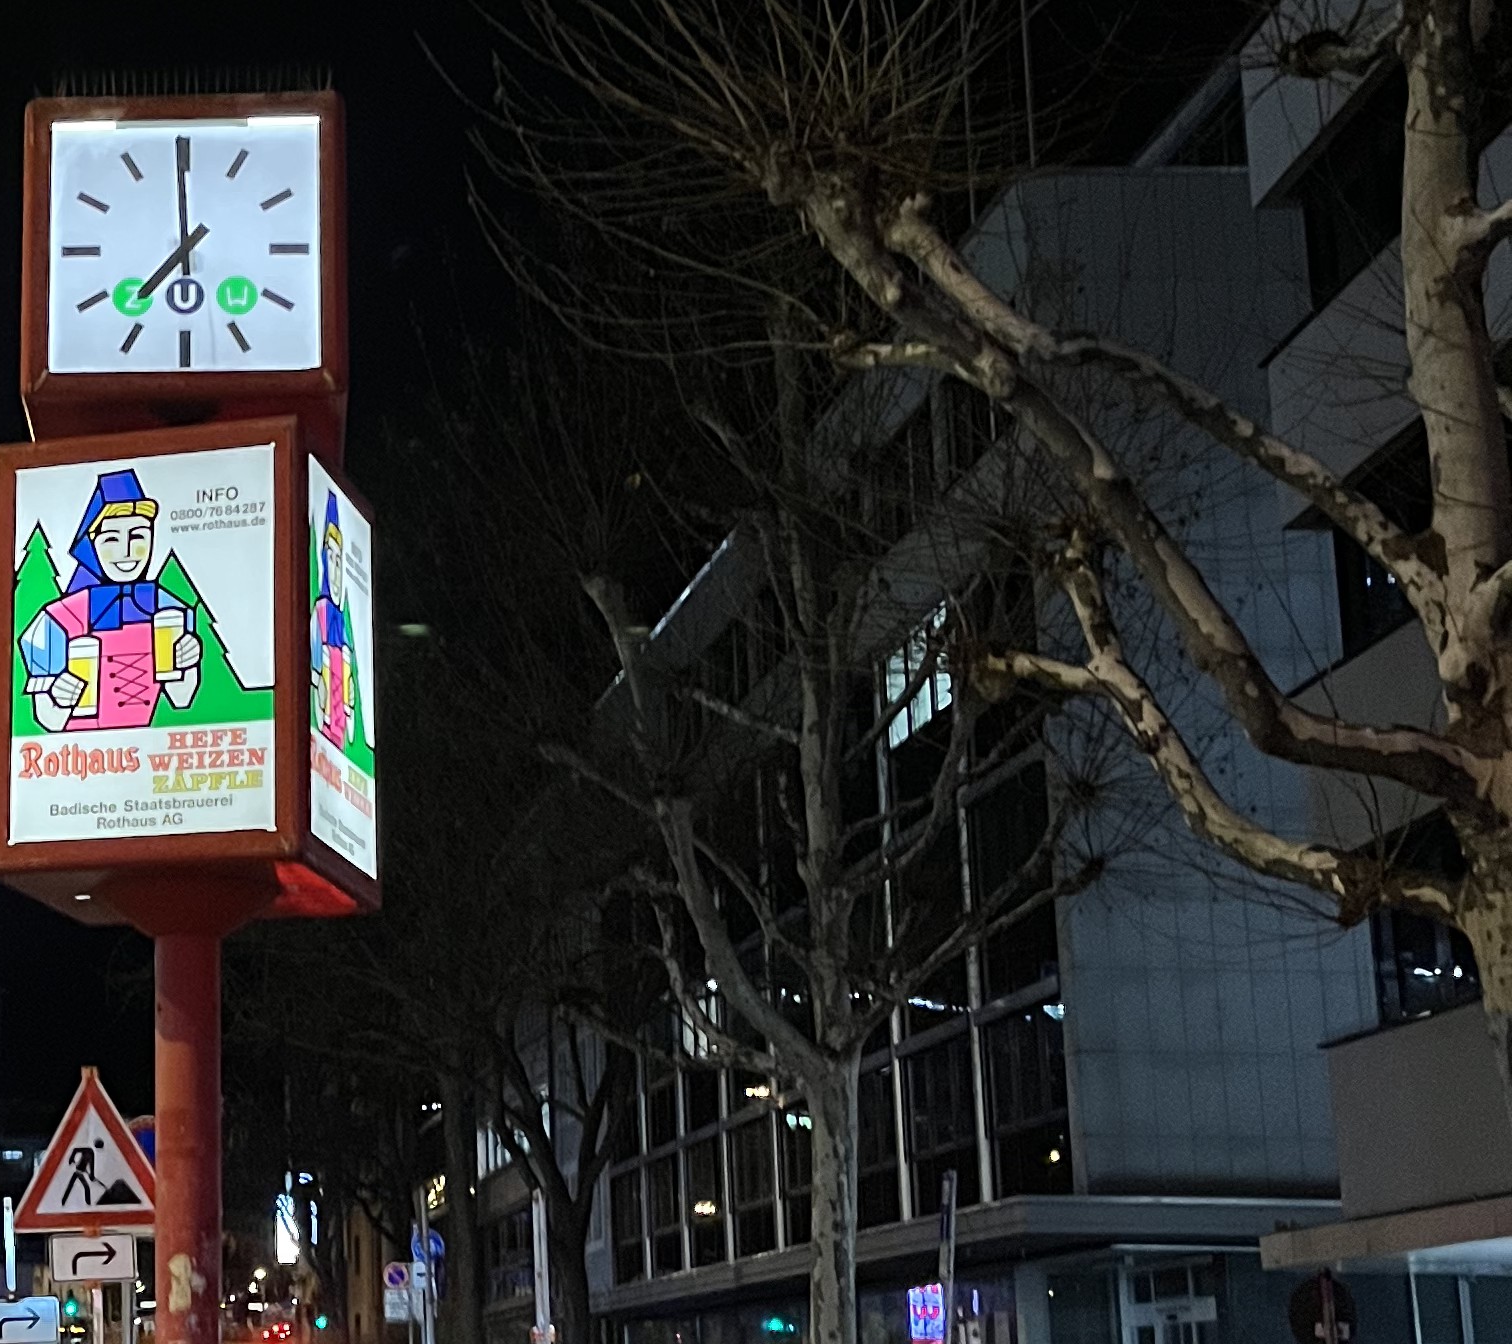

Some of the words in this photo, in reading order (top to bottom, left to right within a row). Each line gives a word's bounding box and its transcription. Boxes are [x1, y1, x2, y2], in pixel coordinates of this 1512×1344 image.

[173, 283, 197, 310] U
[196, 486, 239, 503] INFO
[170, 516, 266, 534] www.rothaus.de
[168, 727, 248, 751] HEFE
[18, 741, 140, 781] Rothaus
[147, 747, 267, 772] WEIZEN
[49, 800, 117, 817] Badische
[123, 793, 233, 813] Staatsbrauerei
[96, 815, 157, 830] Rothaus
[162, 812, 184, 826] AG
